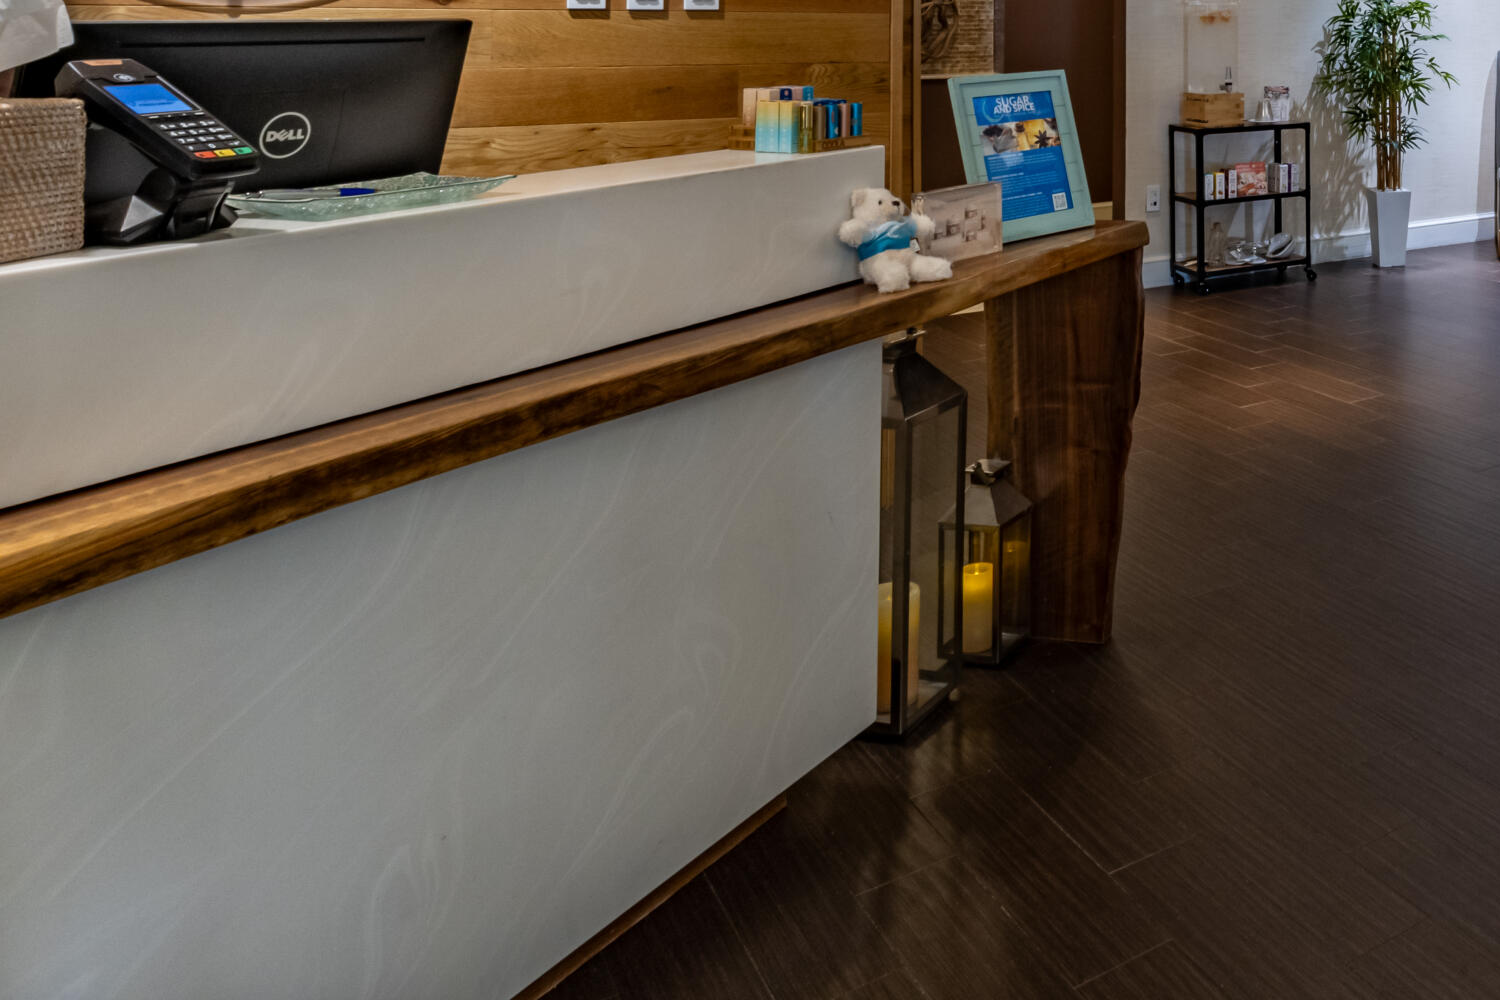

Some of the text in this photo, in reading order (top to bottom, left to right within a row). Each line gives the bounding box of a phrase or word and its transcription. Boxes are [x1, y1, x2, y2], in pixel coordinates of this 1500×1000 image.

[995, 94, 1030, 106] SUGAR
[993, 102, 1036, 115] AND SPICE
[265, 128, 305, 143] DELL
